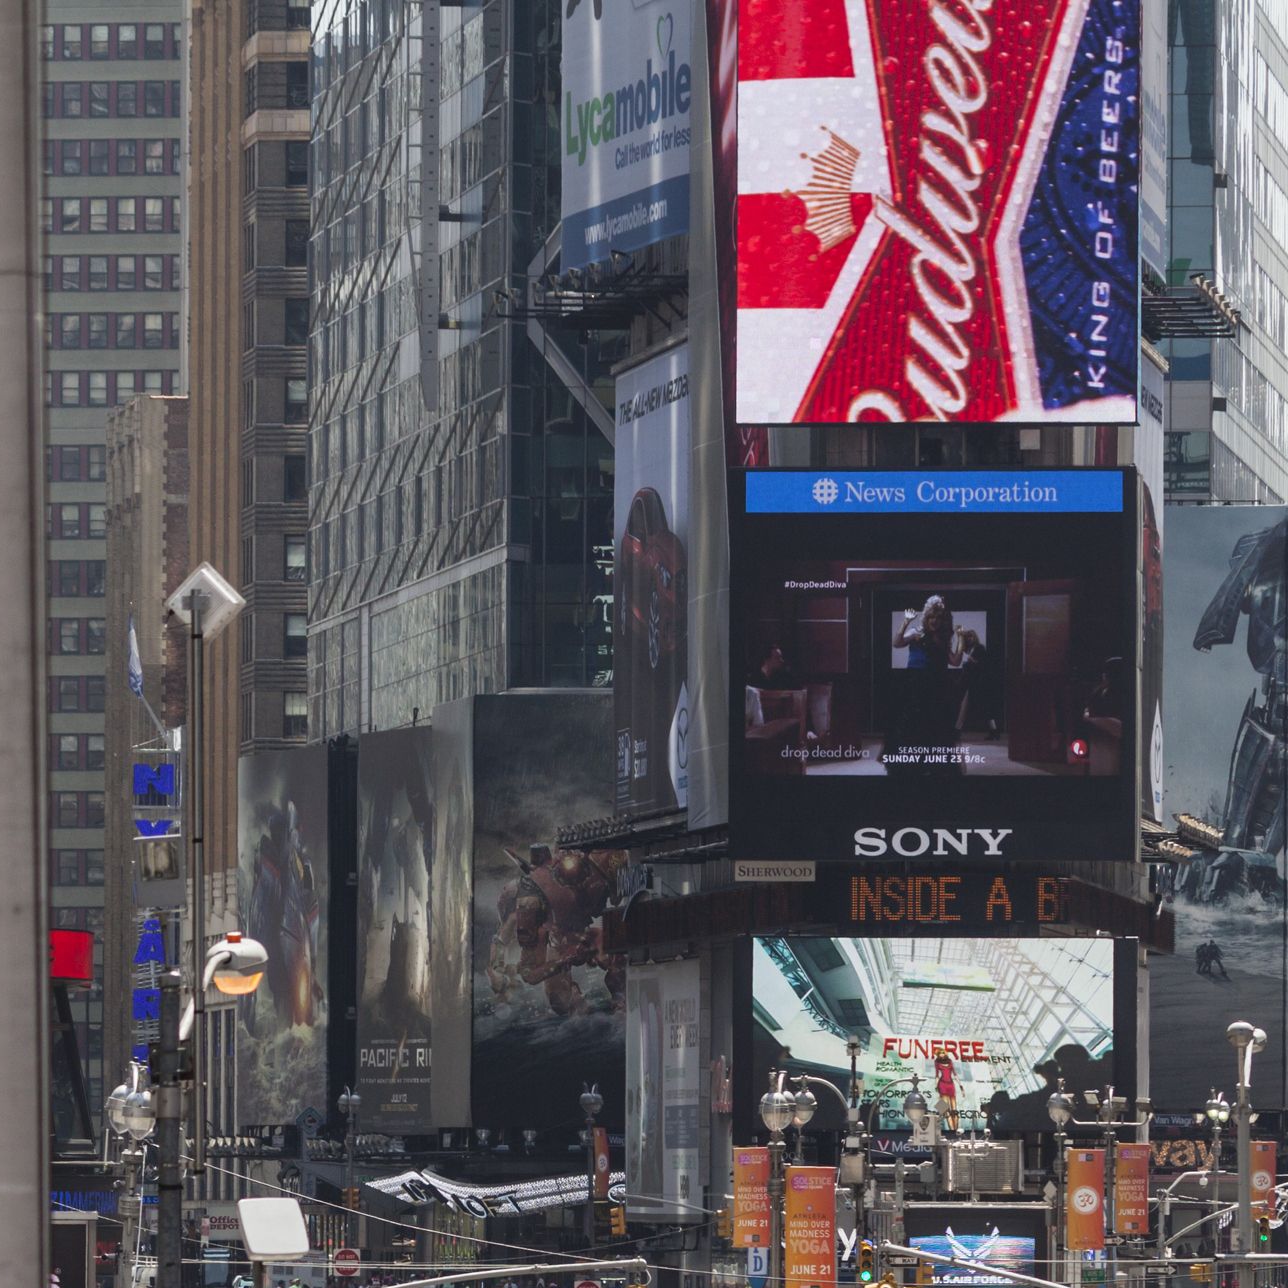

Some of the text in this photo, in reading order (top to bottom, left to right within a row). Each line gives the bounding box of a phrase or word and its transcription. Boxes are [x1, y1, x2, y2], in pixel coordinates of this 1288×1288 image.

[565, 50, 691, 166] Lycamobile
[615, 130, 674, 171] Call world for
[1087, 38, 1124, 389] KING OF BEERS
[619, 397, 634, 426] THE
[844, 480, 1058, 508] News Corporation
[784, 580, 847, 590] #DropDeadDiva
[781, 745, 870, 761] drop dead diva
[898, 746, 970, 755] SEASON PREMIERE
[882, 755, 986, 765] SUNDAY JUNE 23 9/8c
[854, 827, 1013, 857] SONY
[851, 876, 1012, 921] INSIDE A
[360, 1049, 409, 1067] PACIFIC
[737, 1219, 769, 1228] JUNE 21
[789, 1230, 831, 1238] MADNESS
[790, 1240, 830, 1255] YOGA
[790, 1264, 831, 1275] JUNE 21
